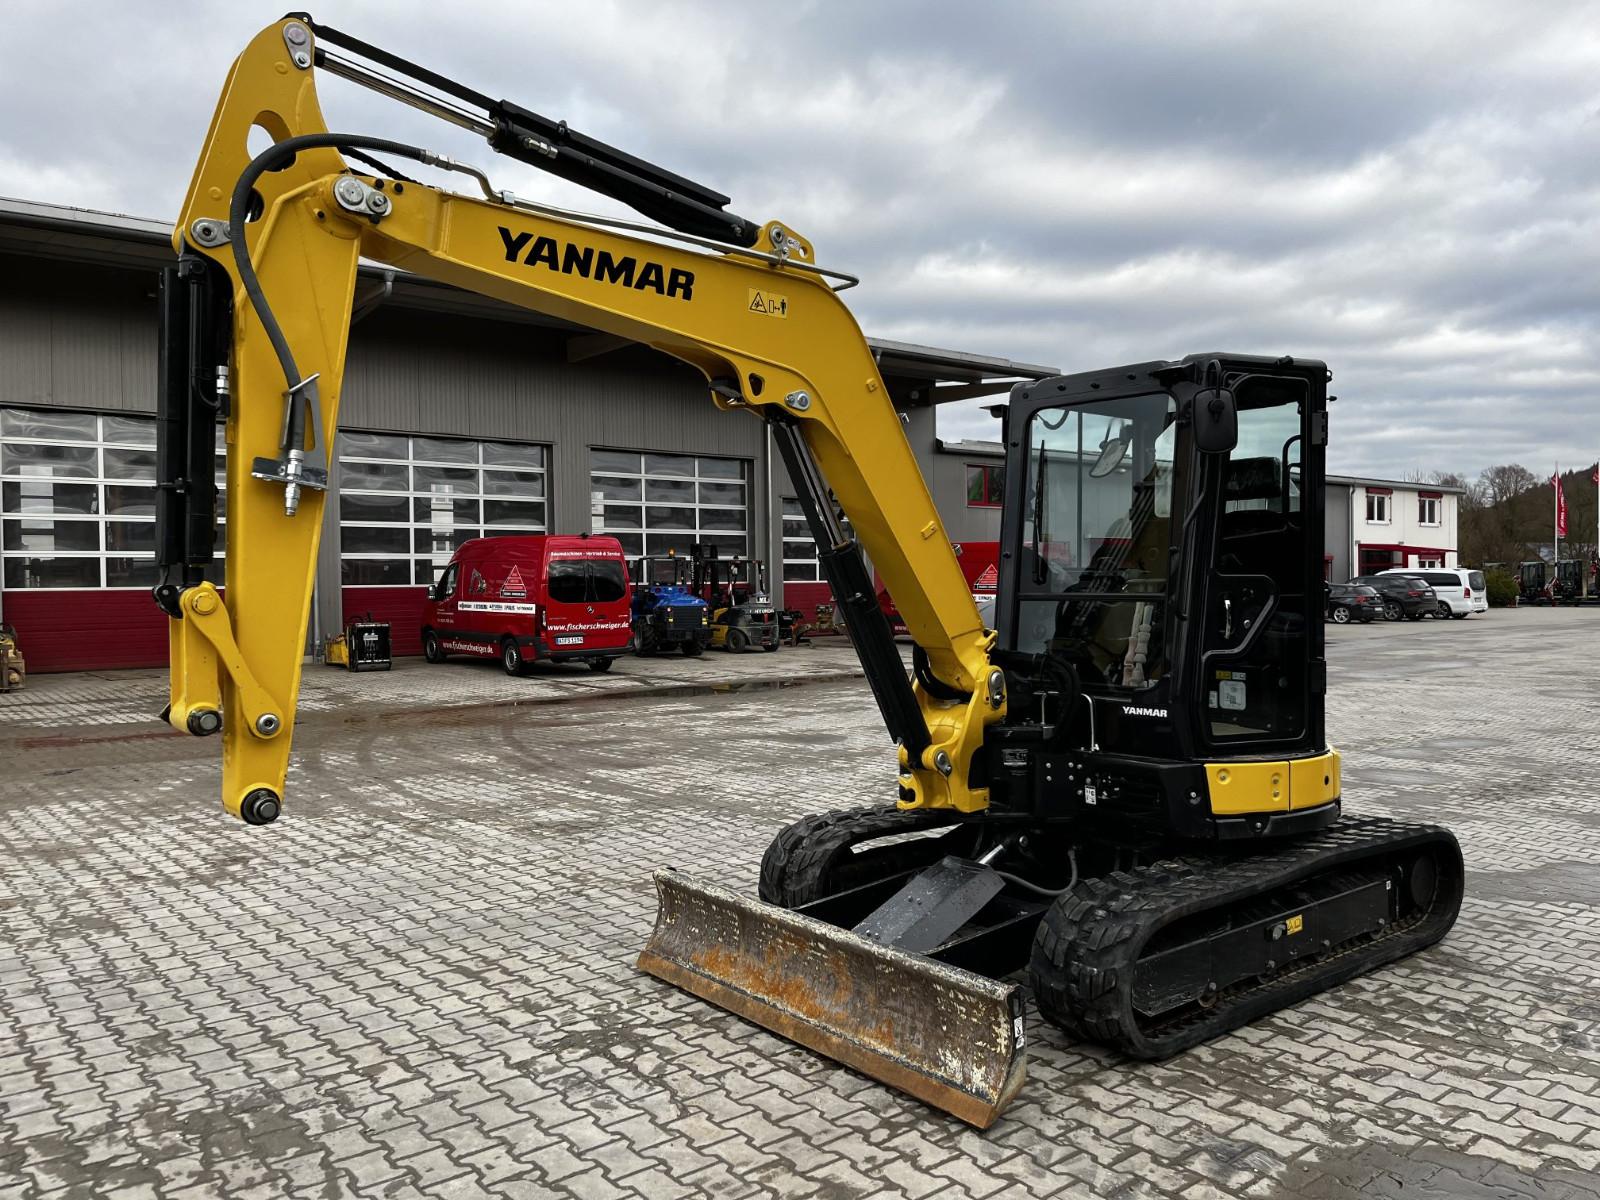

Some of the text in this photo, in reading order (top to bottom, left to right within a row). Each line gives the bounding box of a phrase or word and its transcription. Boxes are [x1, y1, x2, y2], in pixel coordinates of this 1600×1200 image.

[497, 225, 695, 301] YANMAR
[547, 621, 629, 631] www.fischerschweiger.de
[1122, 706, 1168, 718] YANMAR
